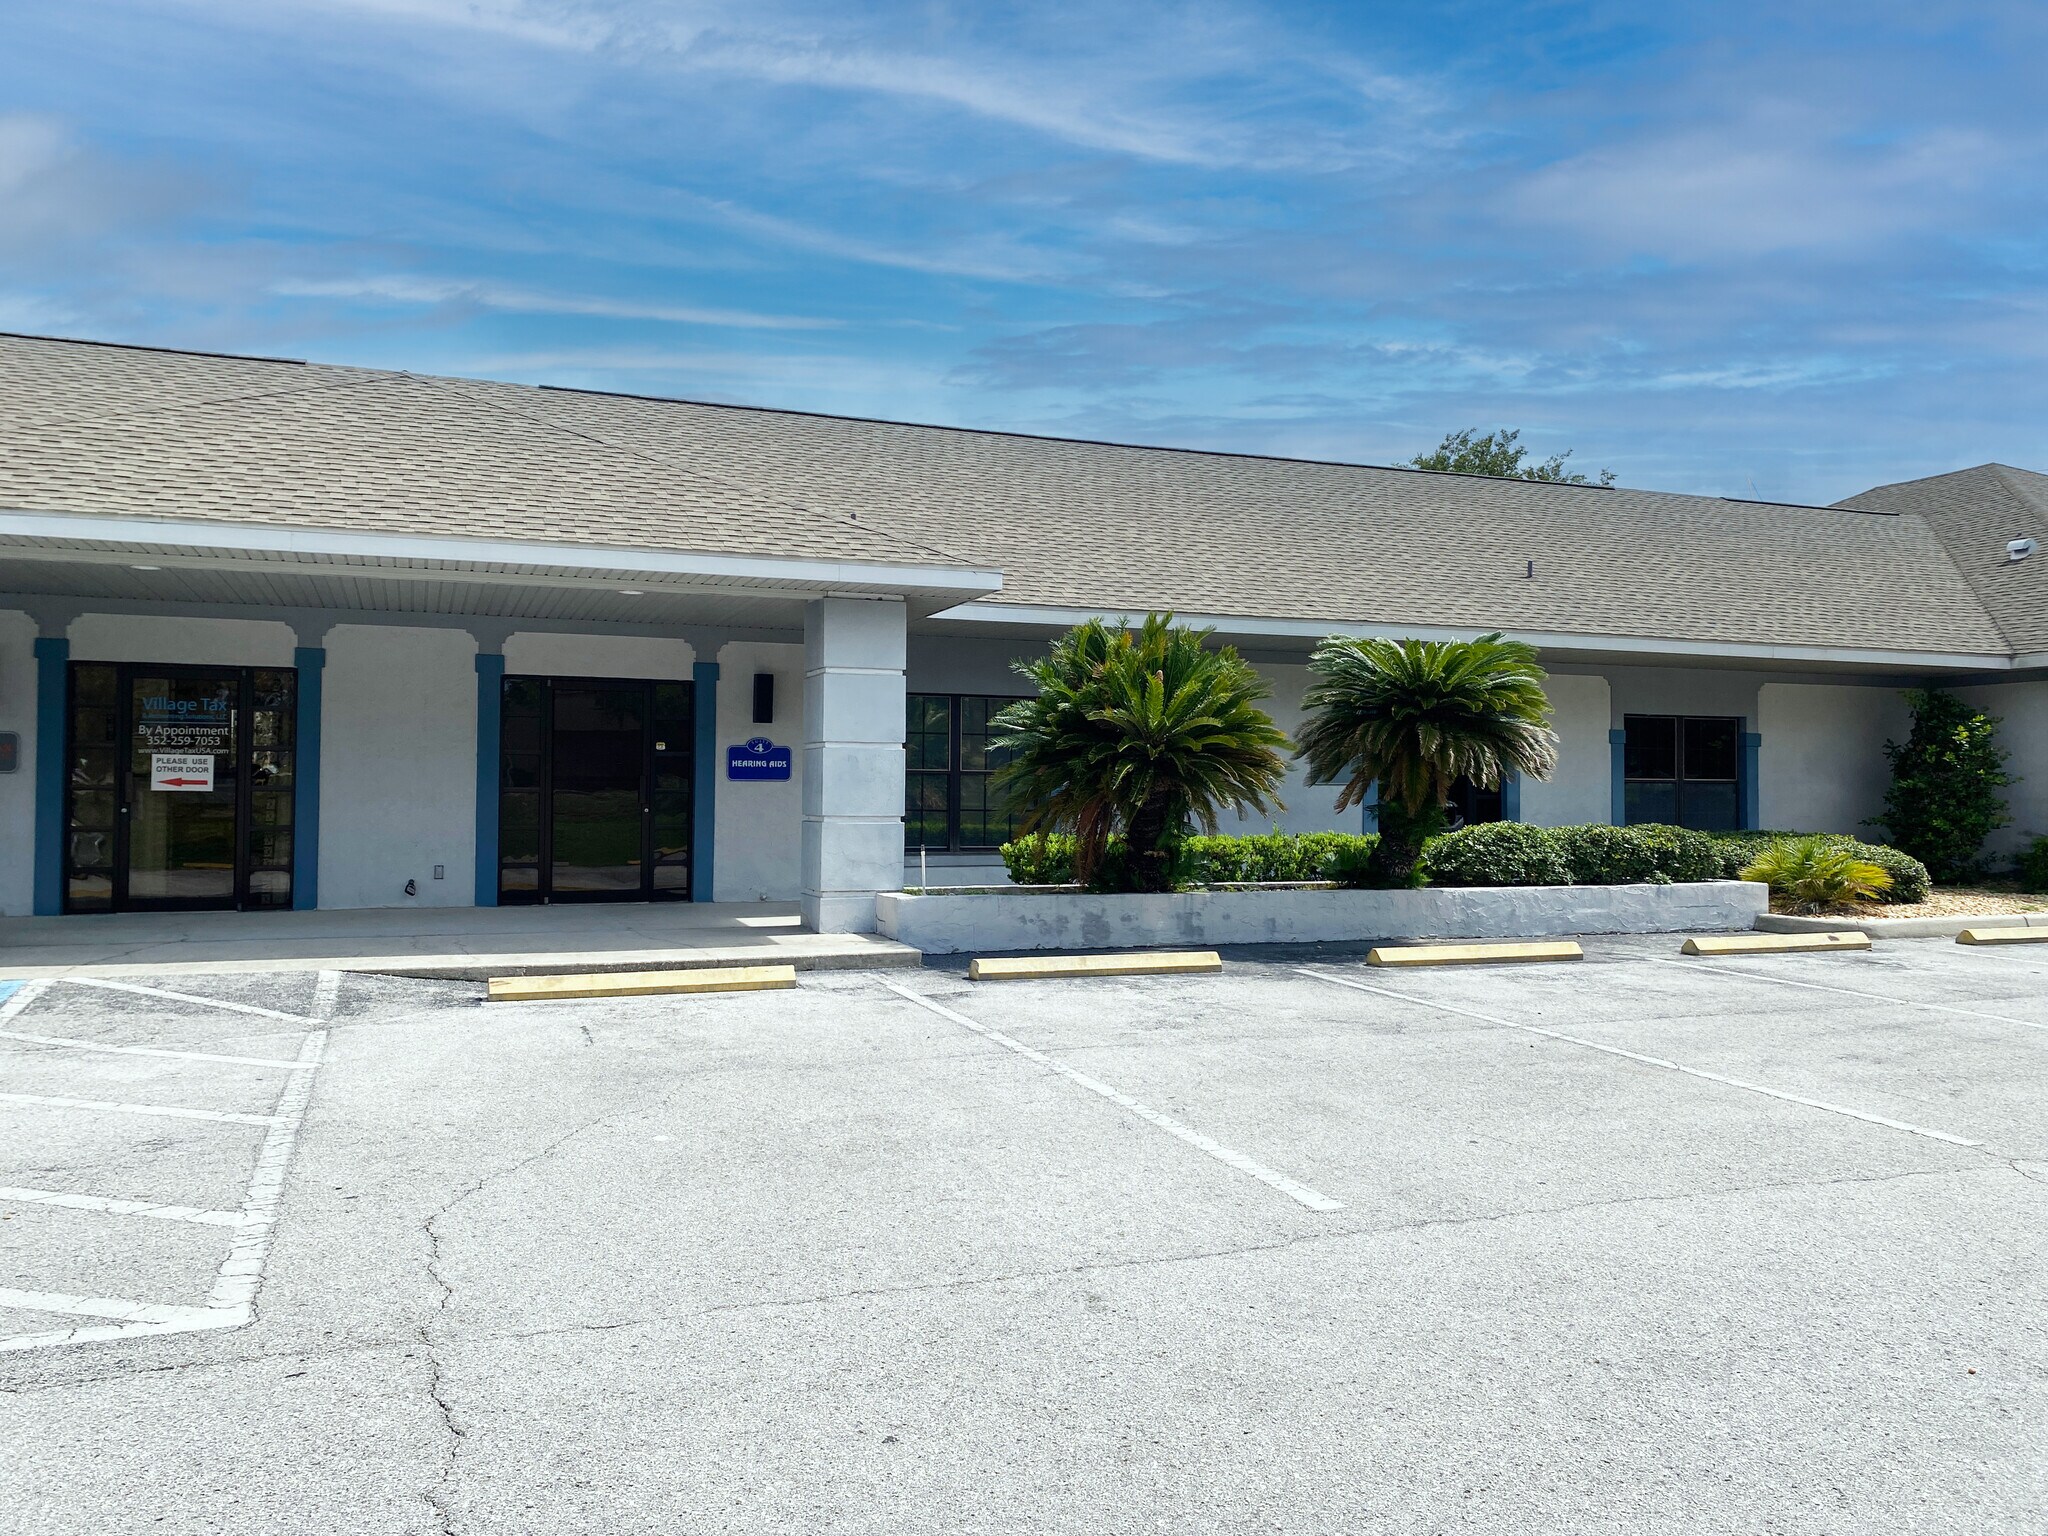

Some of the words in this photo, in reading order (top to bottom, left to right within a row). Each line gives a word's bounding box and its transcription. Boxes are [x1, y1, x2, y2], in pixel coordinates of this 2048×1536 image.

[143, 697, 197, 713] Village
[200, 698, 227, 711] Tax
[138, 725, 153, 736] By
[155, 725, 229, 736] Appointment
[146, 736, 221, 746] 352-259-7053
[137, 747, 229, 755] www.VillageTaxUSA.com
[754, 743, 765, 752] 4
[732, 760, 767, 768] HEARING
[769, 760, 787, 768] AIDS
